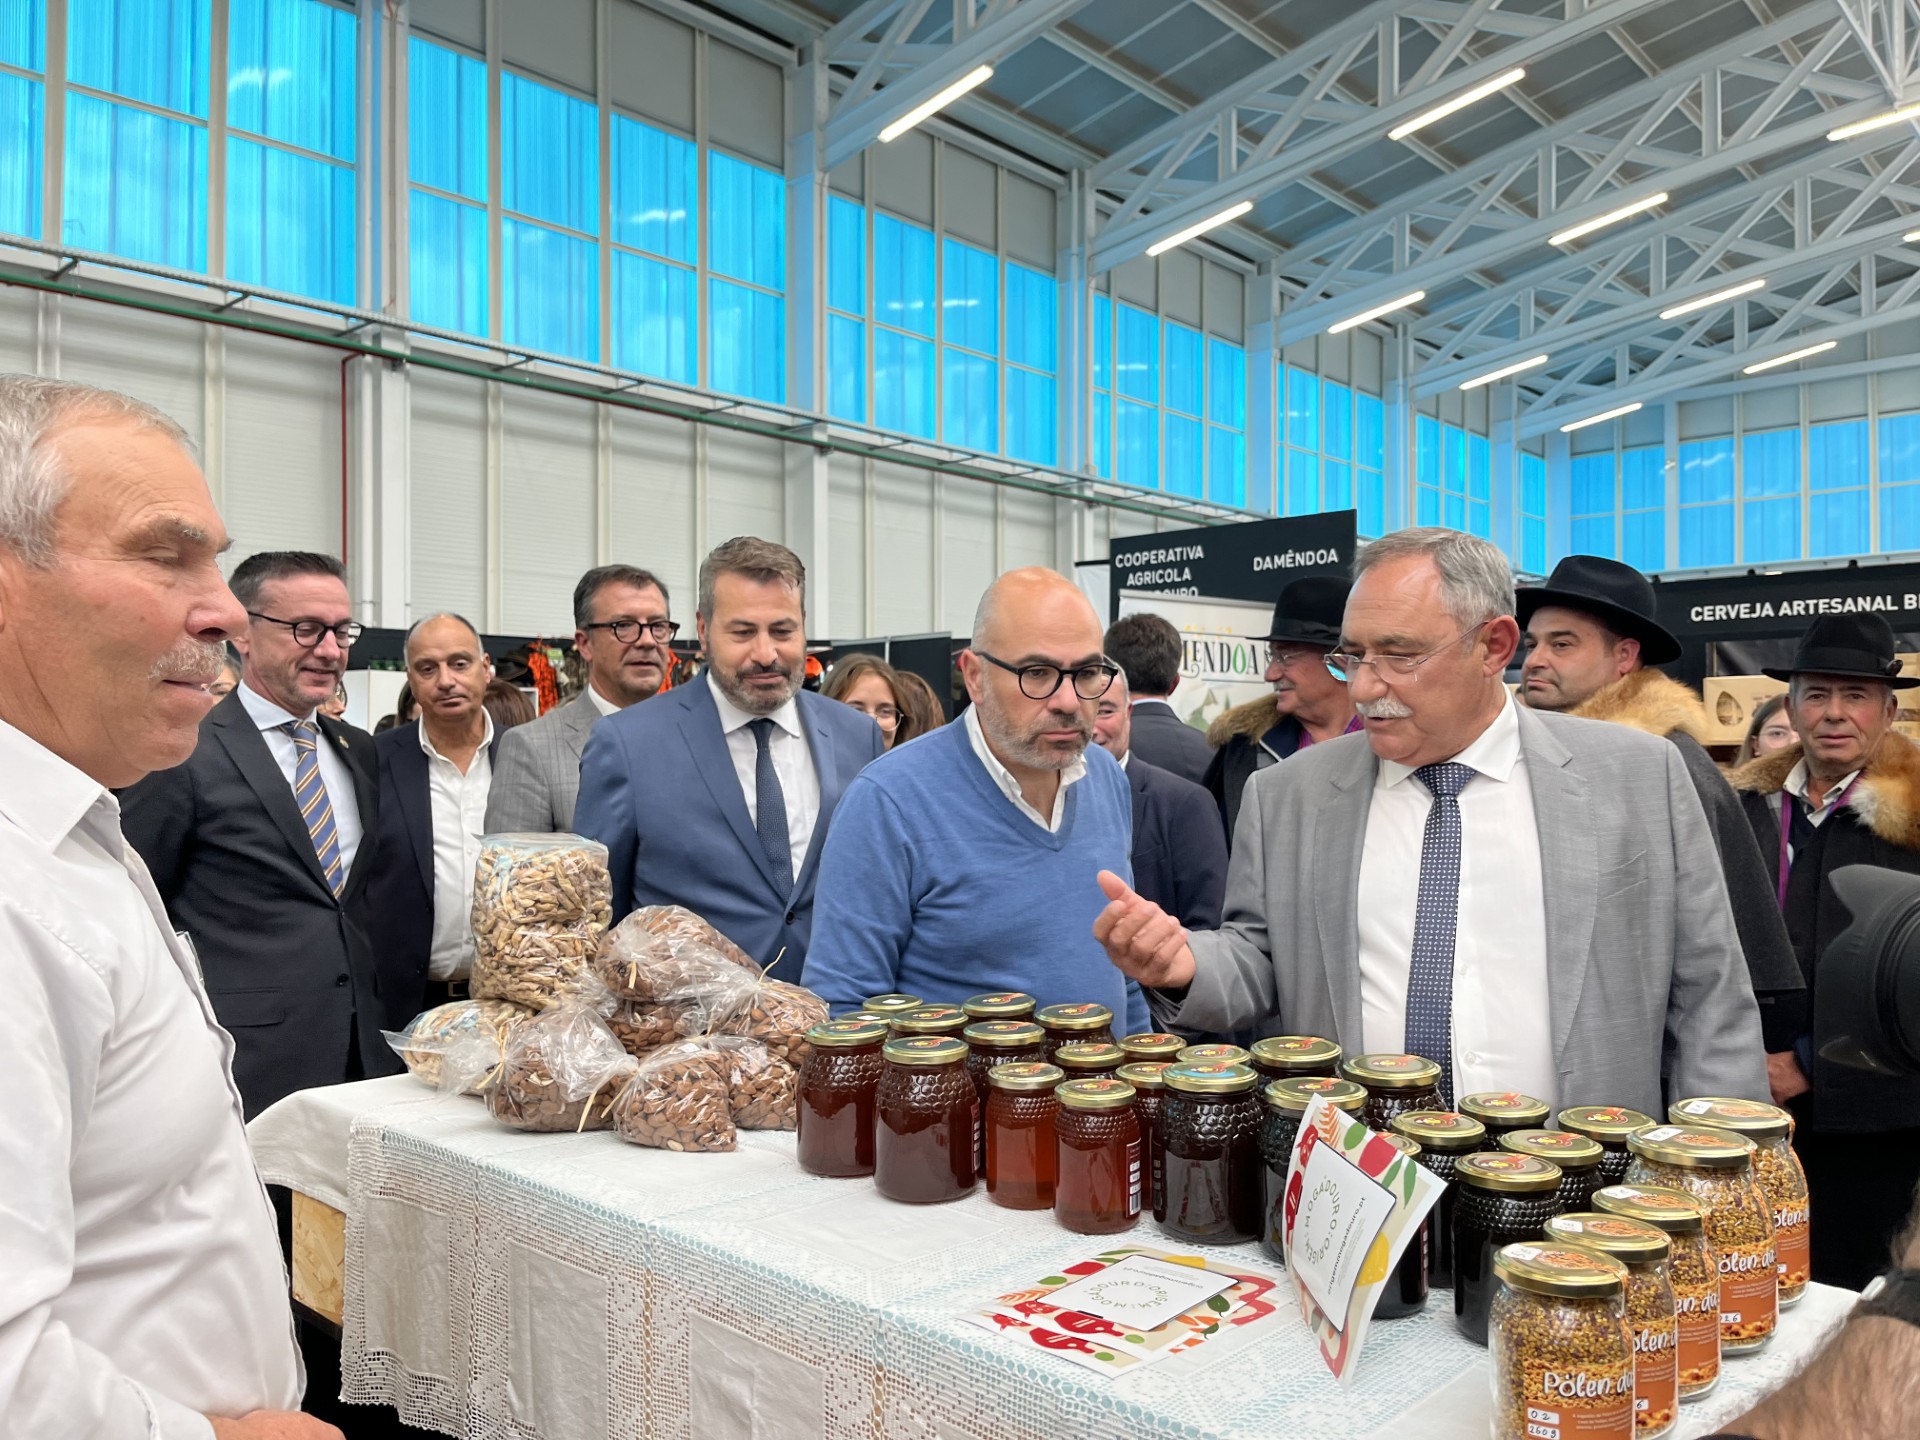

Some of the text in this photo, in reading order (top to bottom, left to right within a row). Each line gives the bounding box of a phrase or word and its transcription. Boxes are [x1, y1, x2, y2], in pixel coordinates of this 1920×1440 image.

[1115, 545, 1204, 568] COOPERATIVA
[1253, 548, 1339, 572] DAMÊNDOA
[1126, 567, 1192, 587] AGRICOLA
[1690, 602, 1775, 622] CERVEJA
[1778, 595, 1899, 618] ARTESANAL
